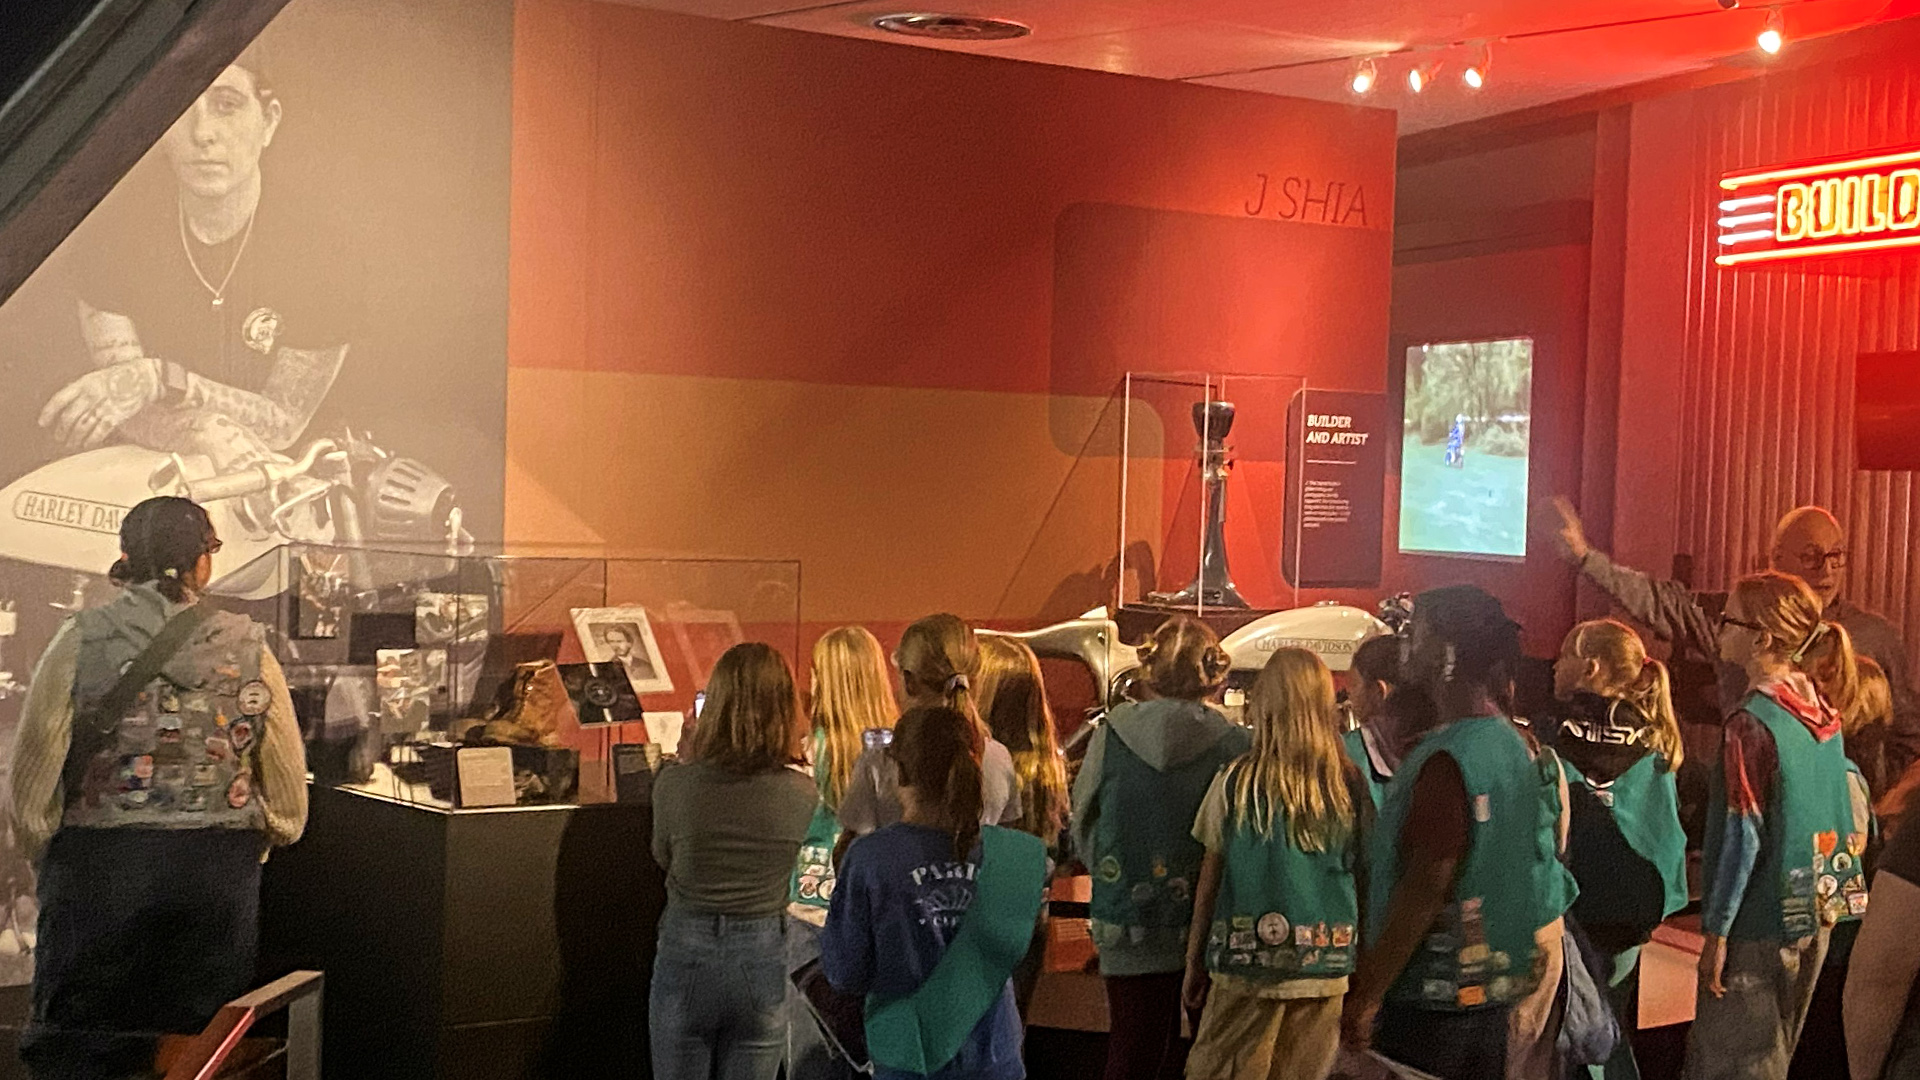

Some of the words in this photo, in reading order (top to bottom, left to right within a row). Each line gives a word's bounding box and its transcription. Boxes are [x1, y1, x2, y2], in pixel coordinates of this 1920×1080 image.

[1244, 173, 1268, 216] J
[1278, 176, 1367, 226] SHIA
[1306, 414, 1352, 429] BUILDER
[1305, 431, 1330, 444] AND
[1330, 432, 1369, 446] ARTIST
[23, 495, 89, 525] HARLEY
